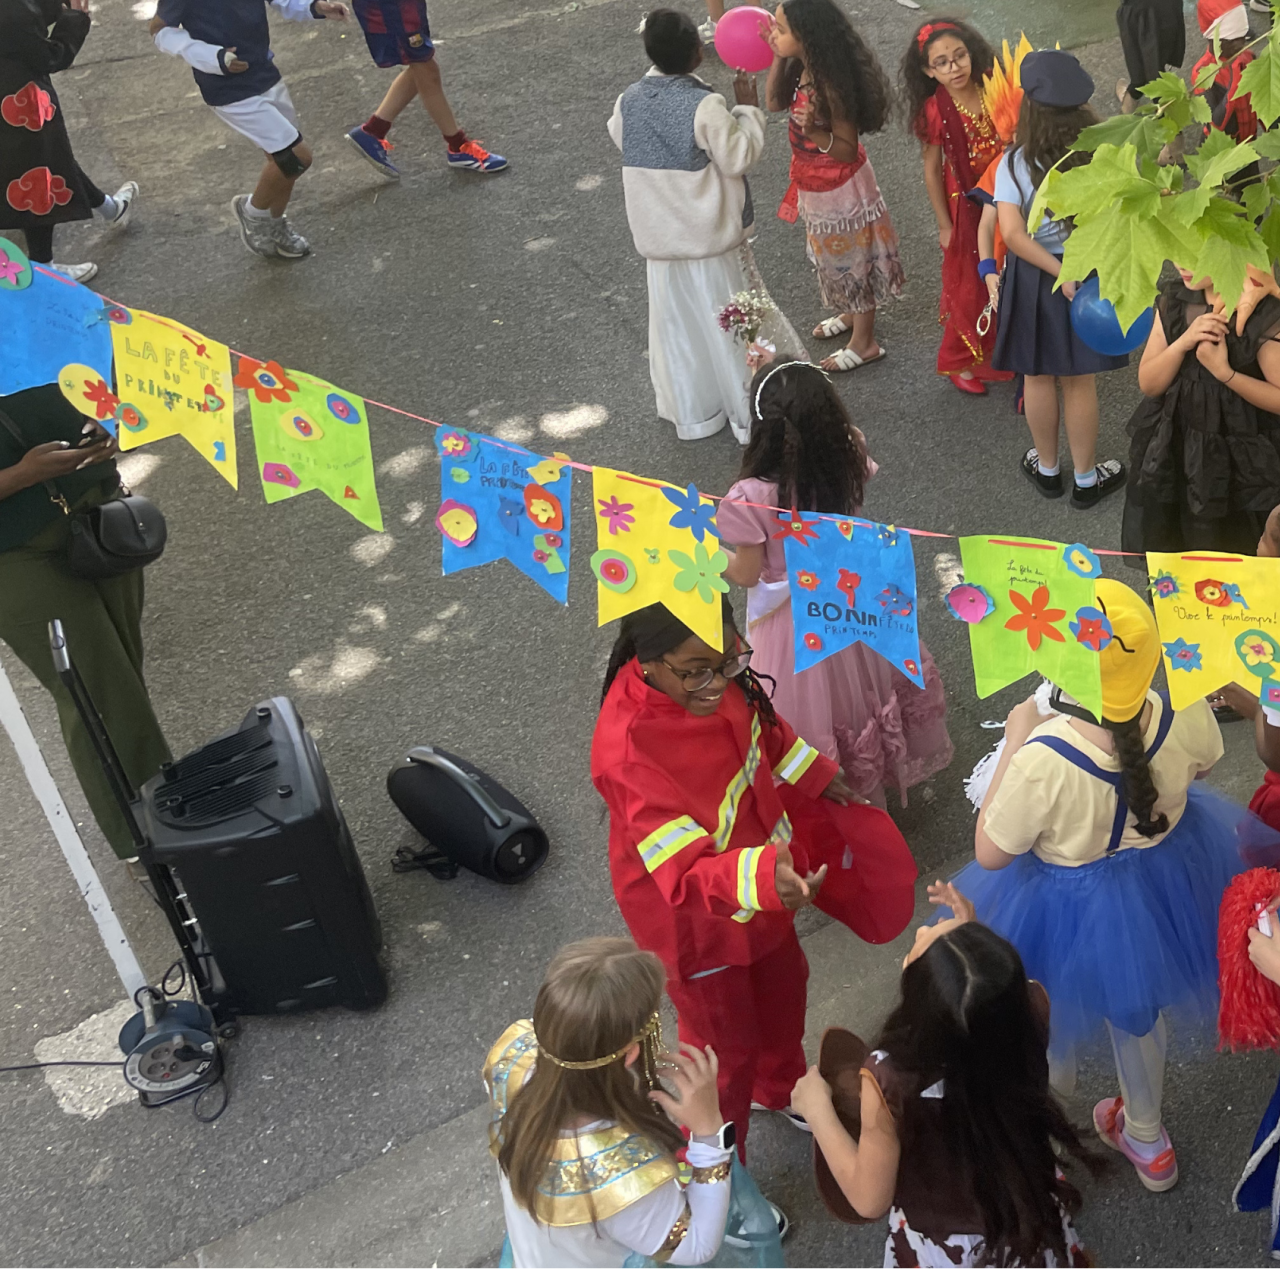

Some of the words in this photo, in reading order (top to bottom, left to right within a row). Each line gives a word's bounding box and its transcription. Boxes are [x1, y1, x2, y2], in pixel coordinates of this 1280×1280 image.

[125, 337, 158, 363] LA
[165, 348, 222, 388] FÊTE
[164, 369, 181, 385] DU
[480, 456, 497, 474] LA
[1173, 606, 1199, 620] Vive
